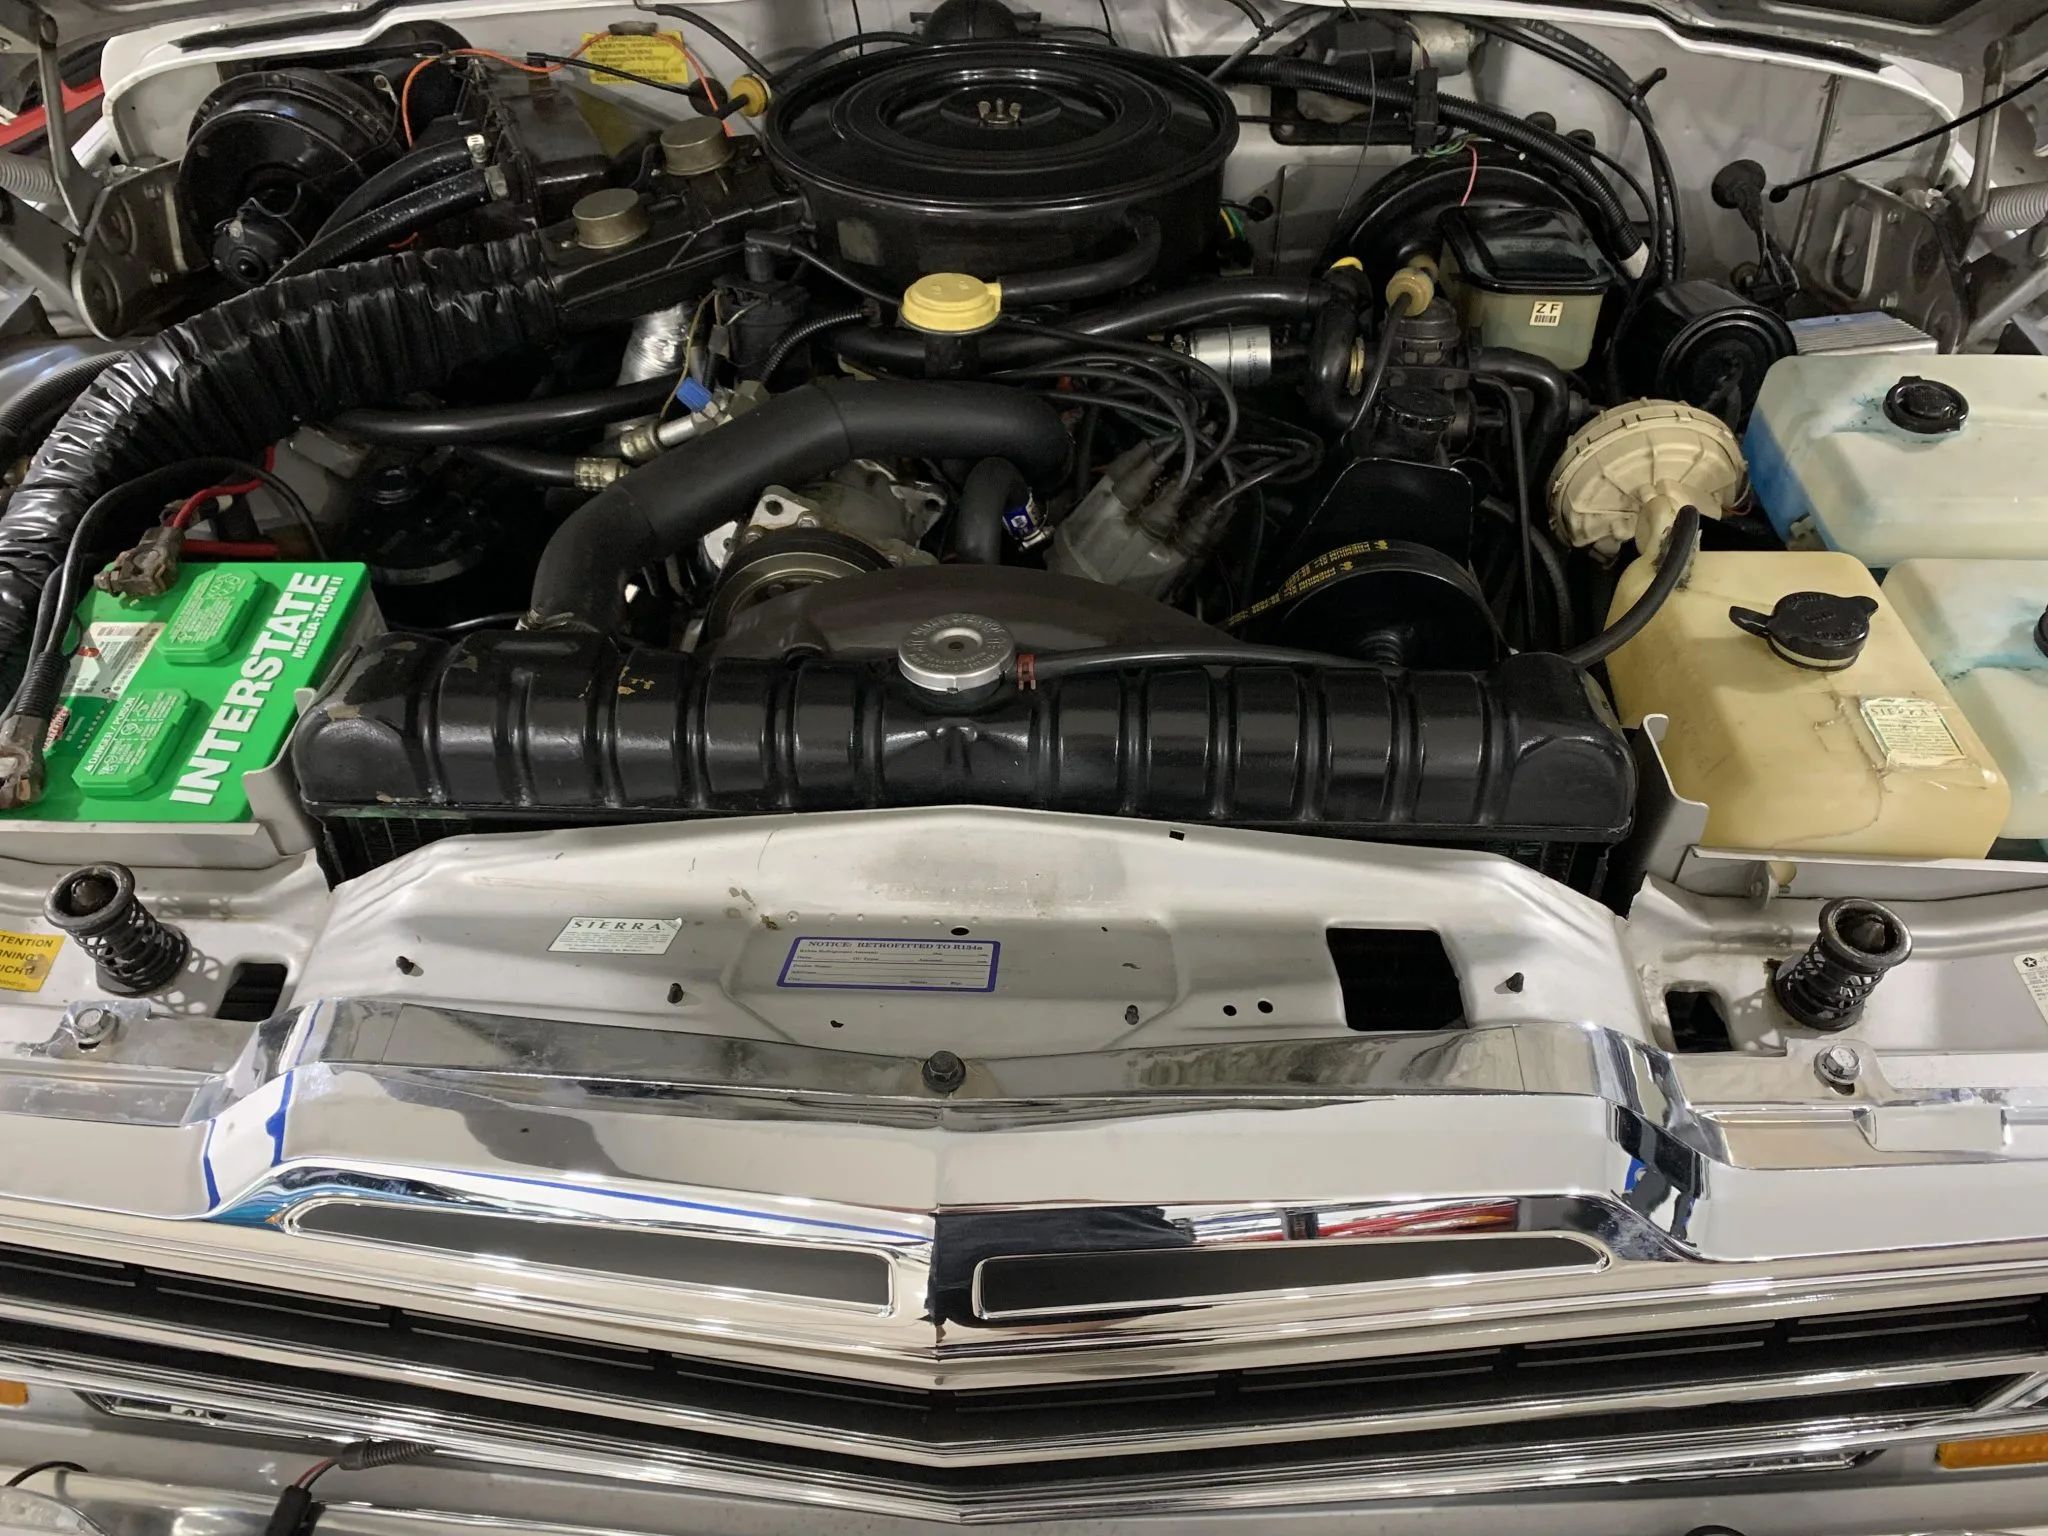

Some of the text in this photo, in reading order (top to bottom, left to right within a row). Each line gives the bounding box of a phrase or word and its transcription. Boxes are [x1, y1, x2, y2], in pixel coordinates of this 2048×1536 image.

[291, 586, 338, 659] MEGA-TRON
[168, 572, 329, 805] INTERSTATE
[571, 921, 662, 930] SIERRA
[808, 940, 984, 952] NOTICE: RETROFITTED TO R134a
